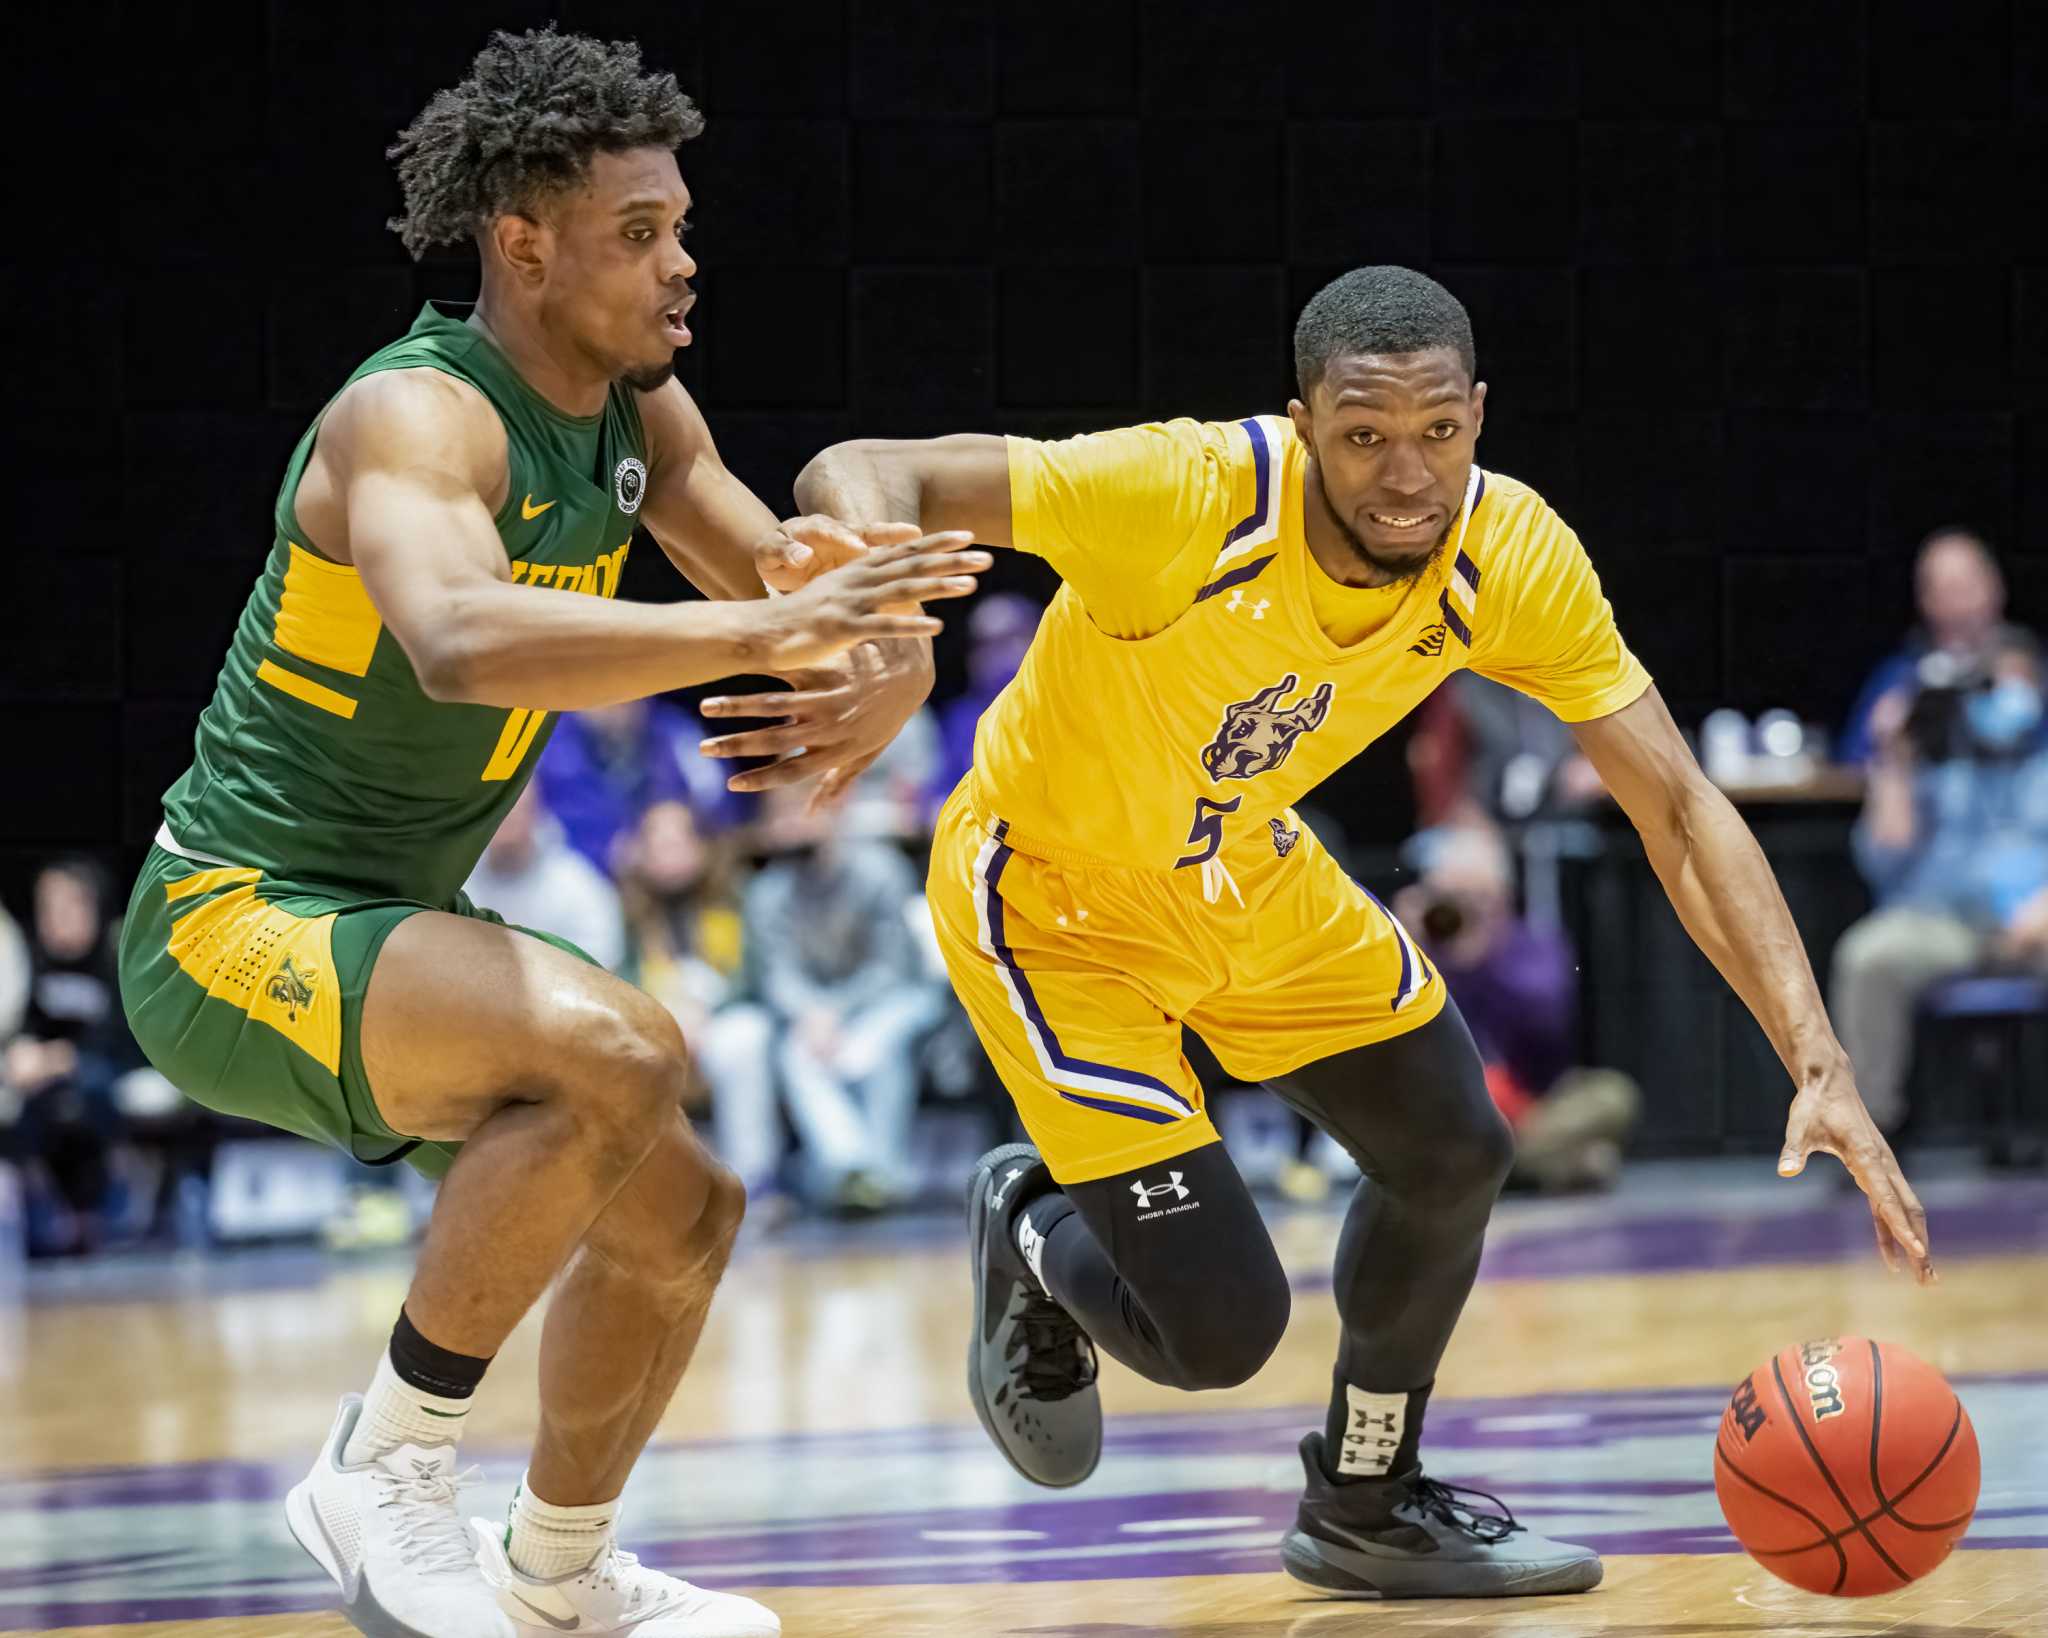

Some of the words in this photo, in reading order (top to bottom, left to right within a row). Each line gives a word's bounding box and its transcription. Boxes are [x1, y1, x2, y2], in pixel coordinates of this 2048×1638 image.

[1173, 796, 1242, 869] 5
[1137, 1209, 1164, 1222] UNDER
[1165, 1201, 1200, 1215] ARMOUR
